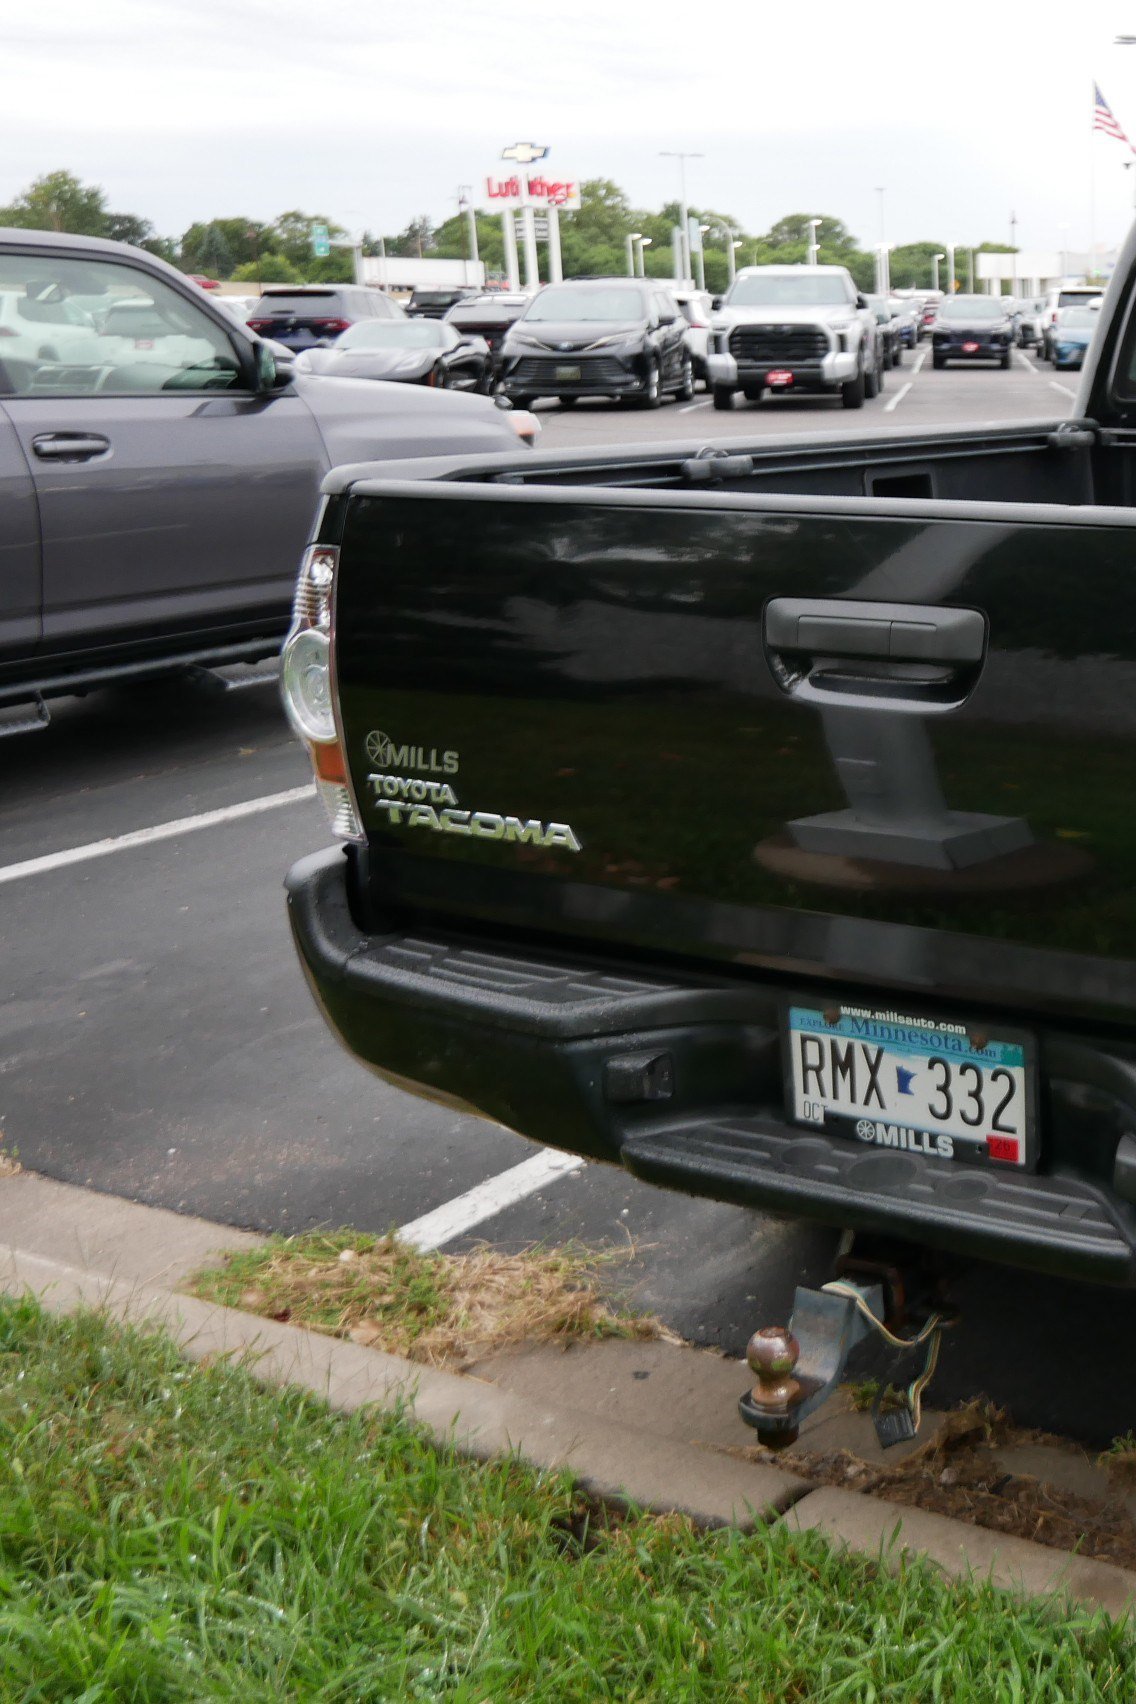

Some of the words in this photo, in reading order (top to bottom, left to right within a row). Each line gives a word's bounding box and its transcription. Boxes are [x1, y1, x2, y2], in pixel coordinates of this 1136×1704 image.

[386, 743, 459, 773] MILLS
[368, 773, 459, 806] TOYOTA
[375, 798, 583, 852] TACOMA
[840, 1005, 967, 1035] www.millsauto.com
[799, 1033, 887, 1110] RMX
[927, 1056, 1018, 1135] 332
[875, 1122, 954, 1159] MILLS
